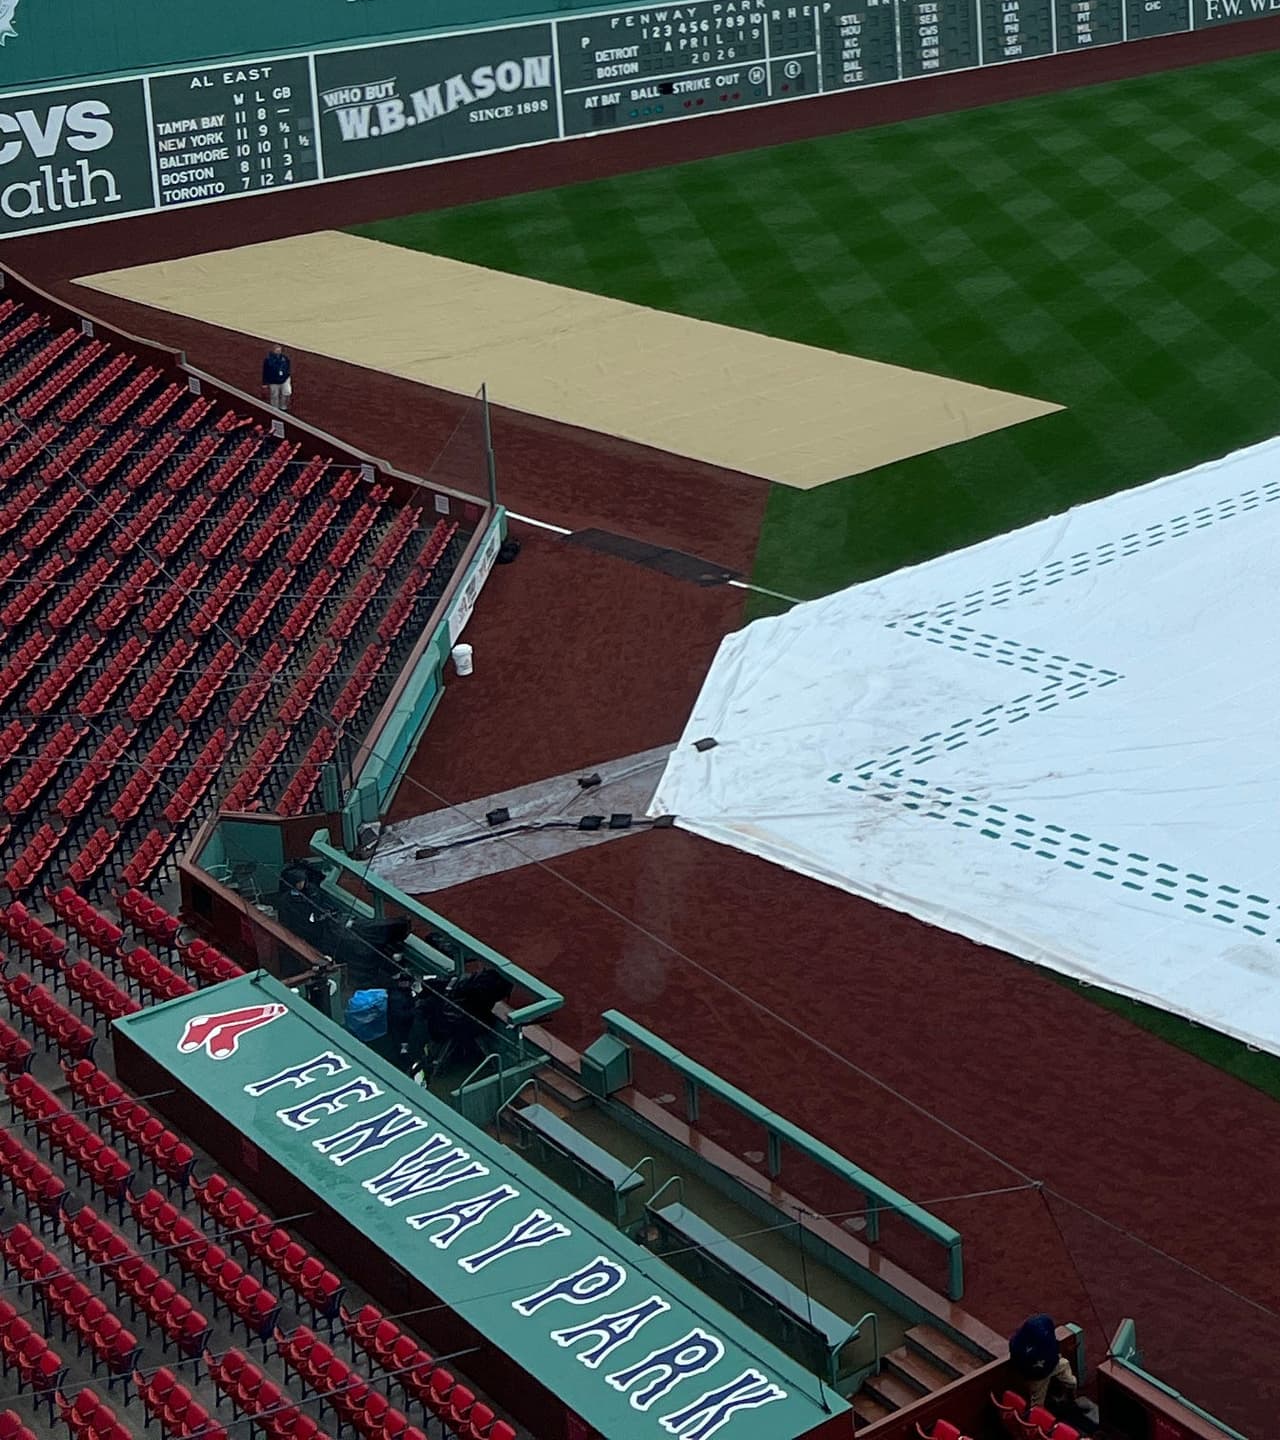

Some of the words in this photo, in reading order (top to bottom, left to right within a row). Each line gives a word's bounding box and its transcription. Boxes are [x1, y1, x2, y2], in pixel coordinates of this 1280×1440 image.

[611, 7, 697, 29] FENWAY
[750, 13, 762, 24] 10
[595, 45, 639, 63] DETROIT
[190, 76, 214, 89] AL
[223, 67, 272, 85] EAST
[597, 62, 639, 79] BOSTON
[234, 93, 244, 106] W
[256, 91, 265, 102] L
[273, 86, 291, 99] GB
[323, 88, 361, 107] WHO
[364, 81, 395, 101] BUT
[336, 55, 552, 142] W.B.MASON
[585, 95, 600, 109] AT
[602, 92, 621, 106] BAT
[631, 86, 660, 101] BALL
[672, 77, 711, 94] STRIKE
[716, 73, 740, 87] OUT
[157, 118, 198, 136] TAMPA
[201, 114, 225, 129] BAY
[235, 110, 246, 124] 11
[257, 108, 266, 120] 8
[469, 106, 514, 123] SINCE
[516, 99, 548, 115] 1898
[158, 137, 186, 153] NEW
[190, 131, 224, 147] YORK
[236, 127, 248, 141] 11
[258, 124, 268, 137] 9
[159, 147, 230, 170] BALTIMORE
[236, 144, 250, 157] 10
[258, 140, 271, 154] 10
[161, 166, 214, 186] BOSTON
[240, 160, 249, 173] 8
[260, 156, 271, 169] 11
[283, 153, 292, 166] 3
[163, 181, 225, 203] TORONTO
[242, 177, 250, 189] 7
[260, 173, 274, 186] 12
[284, 169, 293, 182] 4
[244, 1050, 571, 1274] FENWAY
[511, 1256, 788, 1440] PARK
